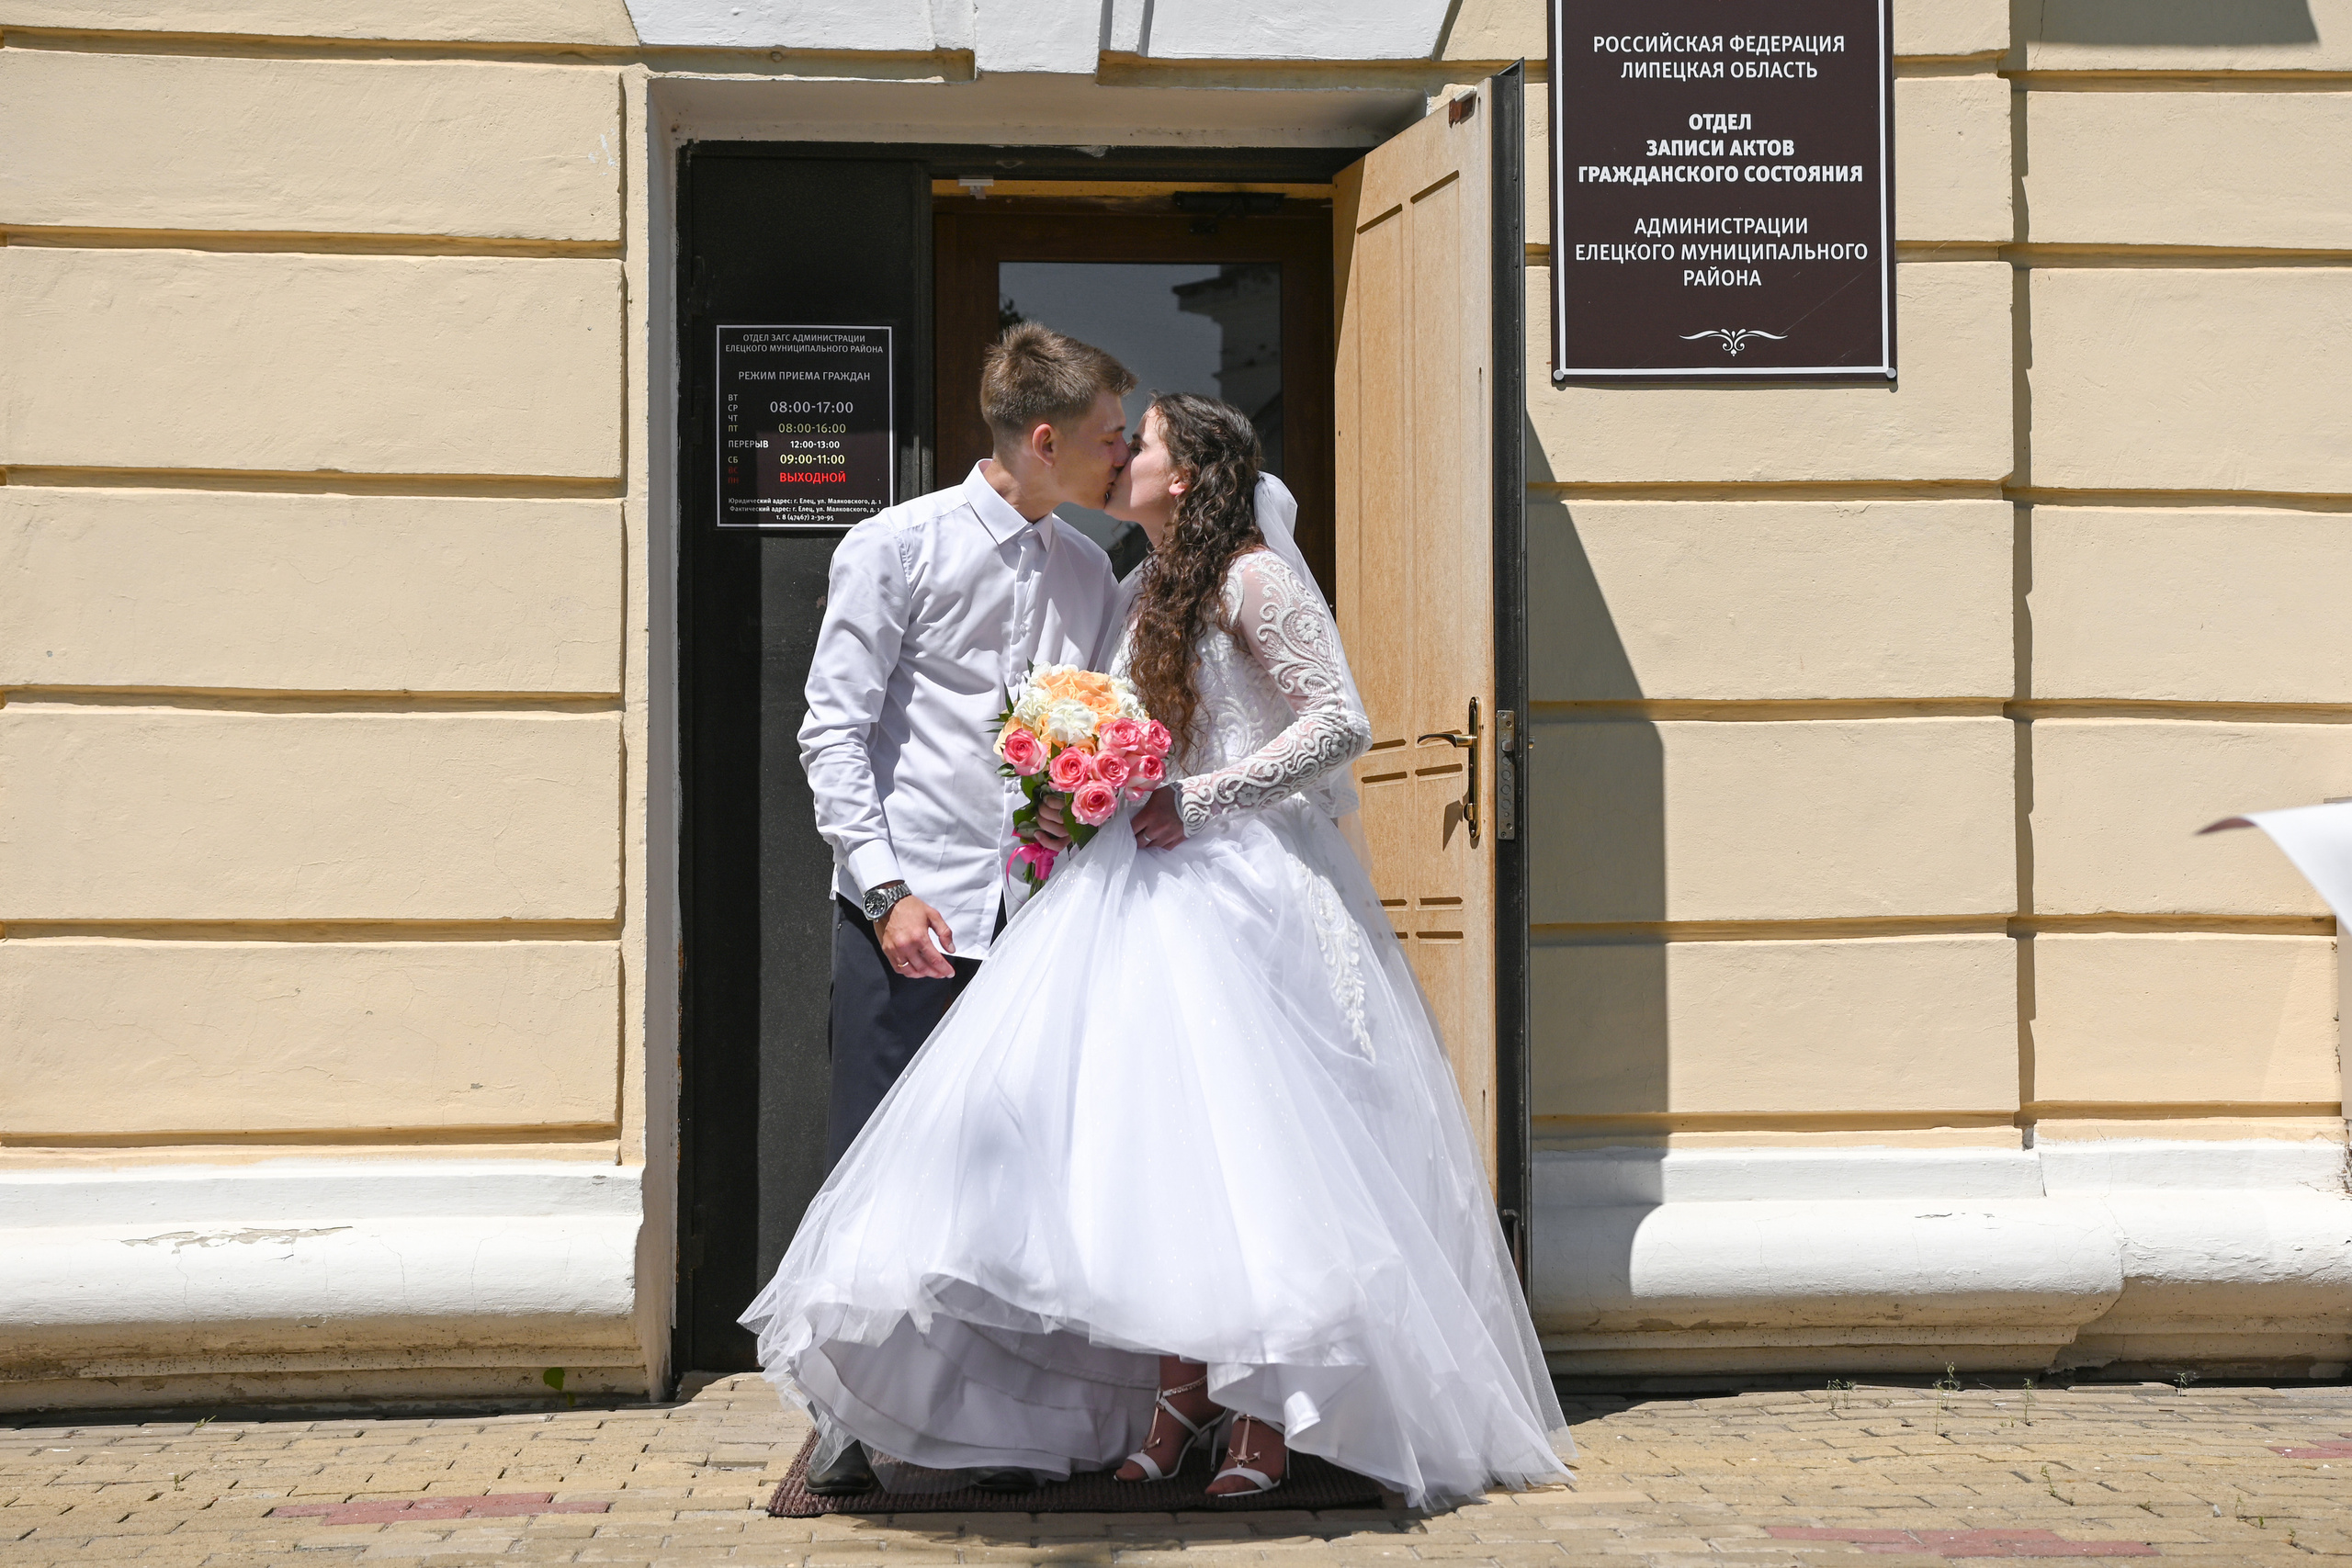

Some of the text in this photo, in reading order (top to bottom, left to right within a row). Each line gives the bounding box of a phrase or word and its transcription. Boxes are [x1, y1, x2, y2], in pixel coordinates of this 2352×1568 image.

[1593, 32, 1845, 55] РОССИЙСКАЯ ФЕДЕРАЦИЯ
[1621, 62, 1817, 82] ЛИПЕЦКАЯ ОБЛАСТЬ
[1689, 113, 1752, 132] ОТДЕЛ
[1646, 140, 1794, 157] ЗАПИСИ АКТОВ
[1578, 165, 1863, 186] ГРАЖДАНСКОГО СОСТОЯНИЯ
[1634, 218, 1808, 238] АДМИНИСТРАЦИИ
[1576, 243, 1868, 264] ЕЛЕЦКОГО МУНИЦИПАЛЬНОГО
[1683, 267, 1762, 287] РАЙОНА
[743, 334, 769, 343] ОТДЕЛ
[792, 334, 865, 343] АДМИНИСТРАЦИИ
[726, 344, 883, 354] ЕЛЕЦКОГО МУНИЦИПАЛЬНОГО РАЙОНА
[739, 371, 870, 382] РЕЖИМ ПРИЕМА ГРАЖДАН
[770, 401, 854, 413] 08:00-17:00
[778, 423, 846, 434] 08:00-16:00
[729, 440, 840, 449] ПЕРЕРЫВ 12:00-13:00
[780, 455, 845, 465] 09:00-11:00
[780, 471, 846, 484] ВЫХОДНОЙ
